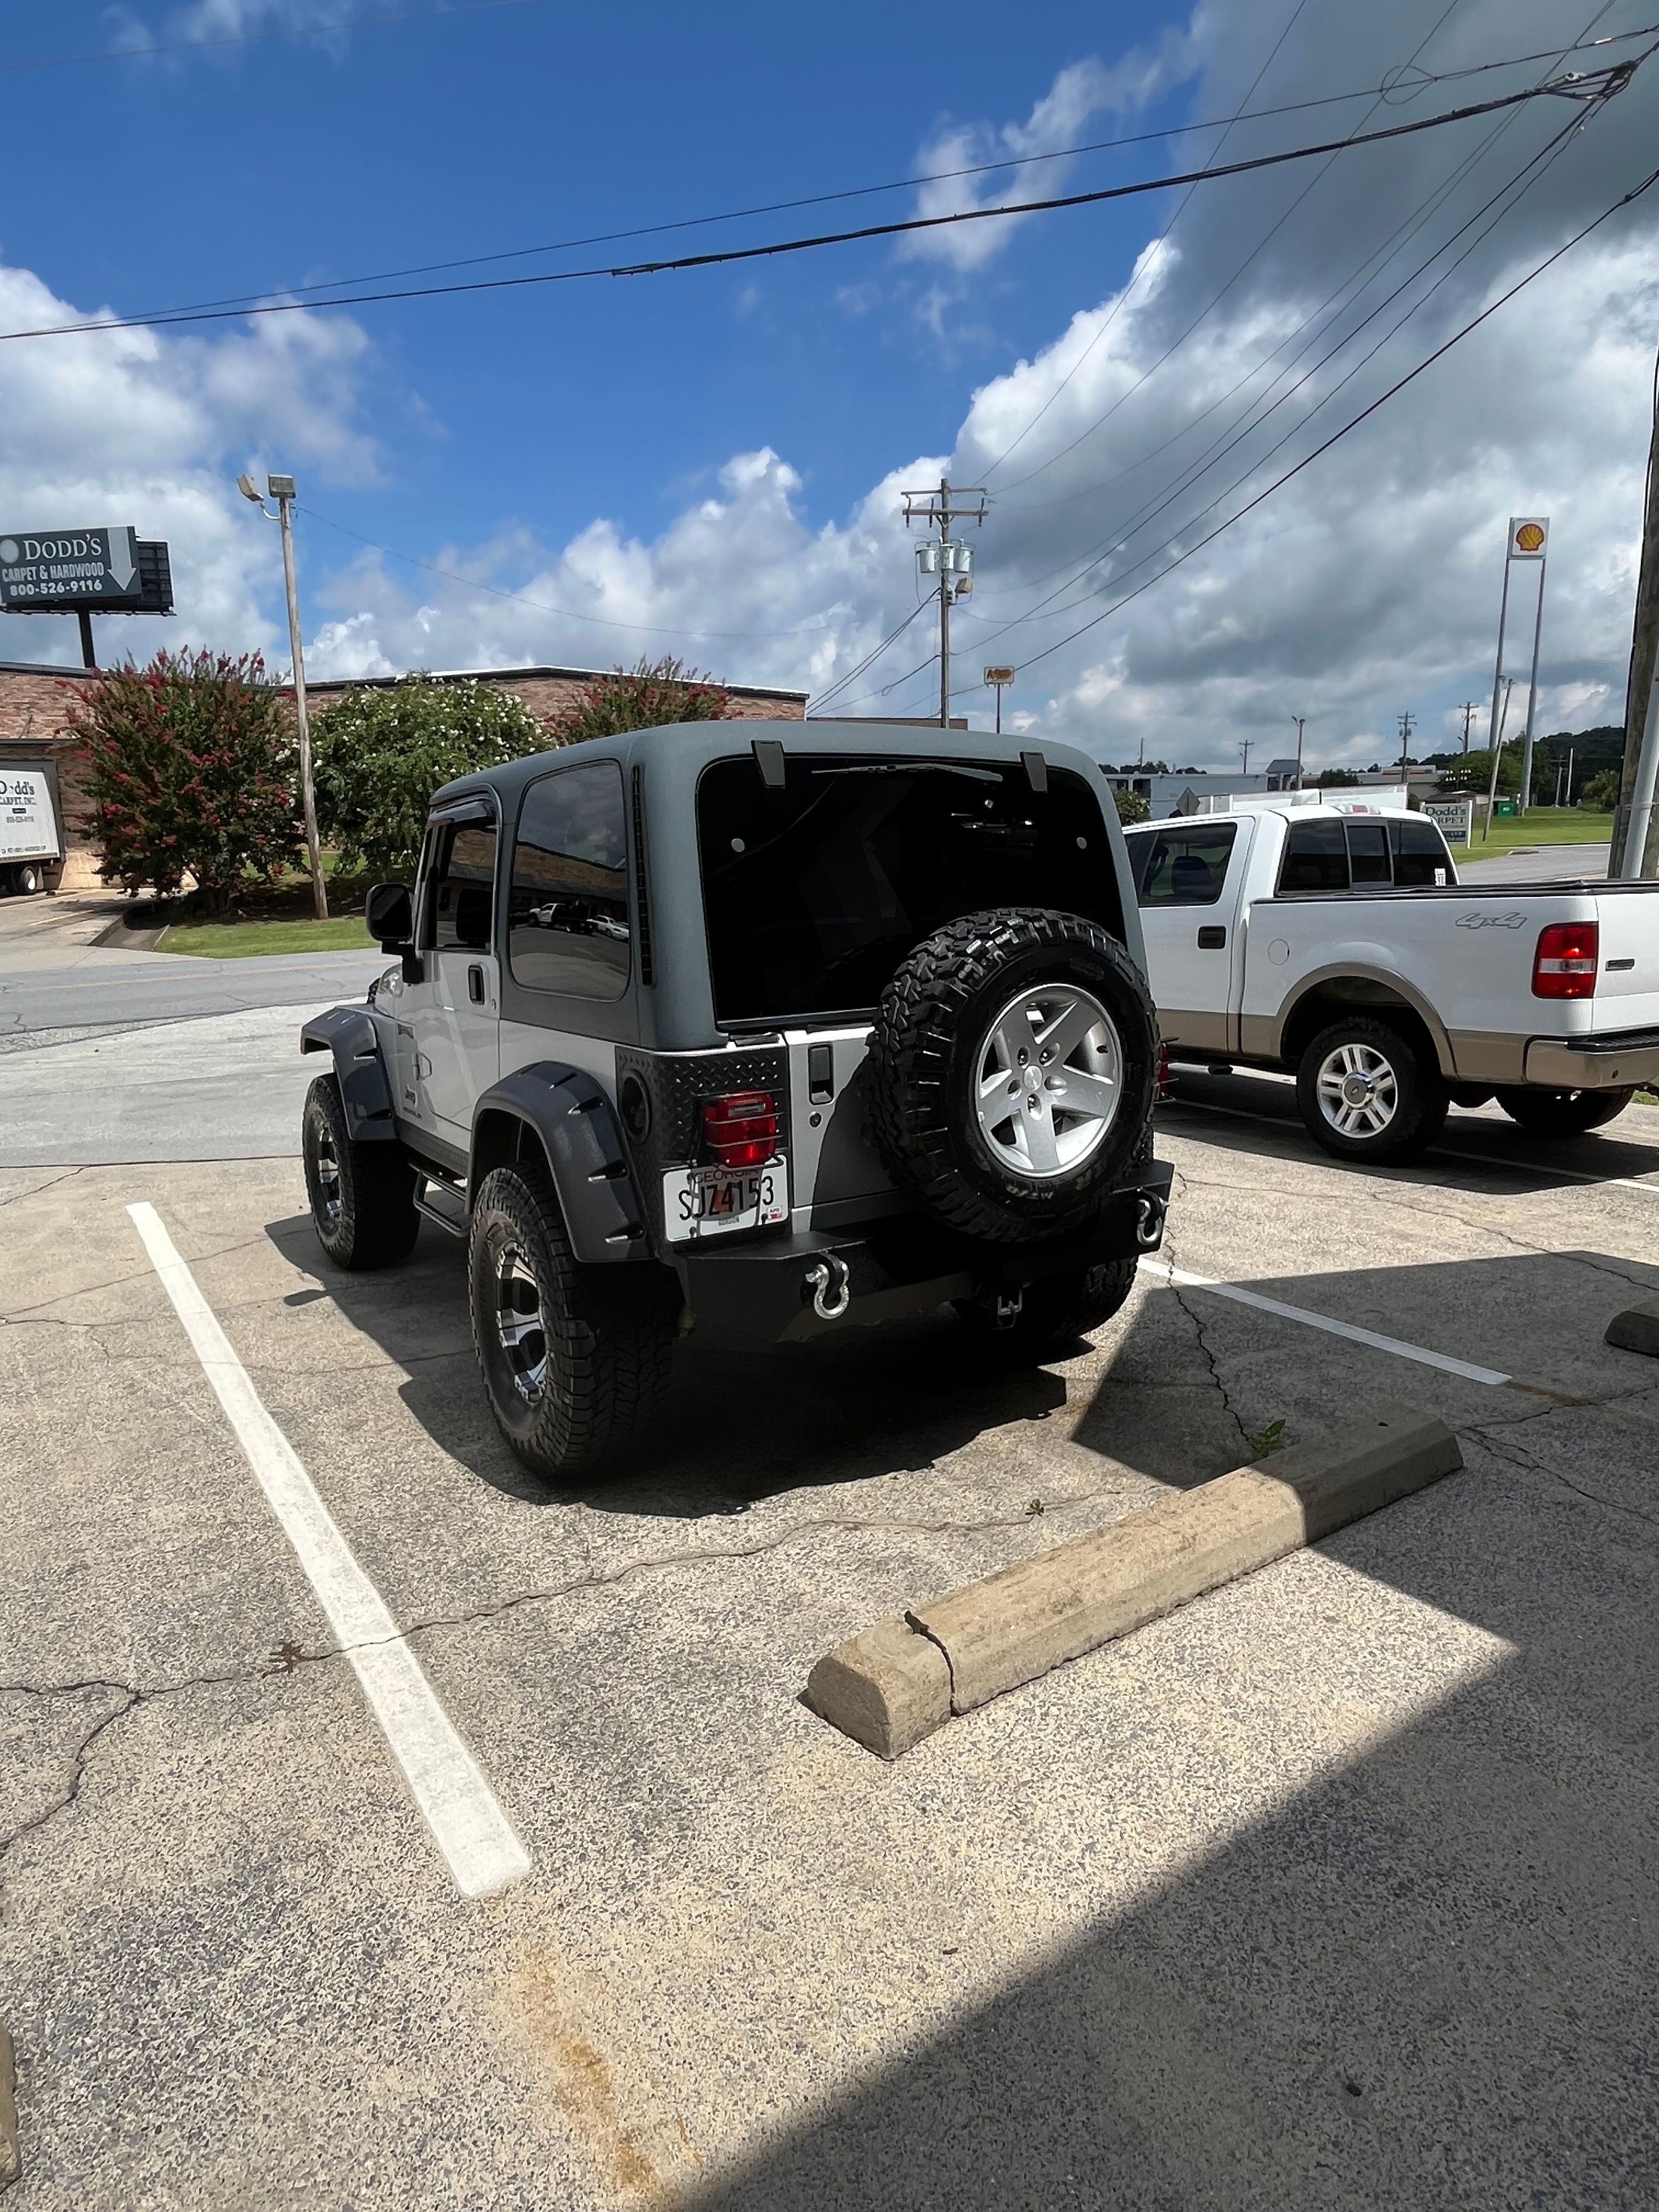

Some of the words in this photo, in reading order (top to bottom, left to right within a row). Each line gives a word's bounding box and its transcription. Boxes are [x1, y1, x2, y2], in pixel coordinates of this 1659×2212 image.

[23, 534, 103, 560] DODD'S
[2, 566, 37, 582] CARPET
[40, 565, 48, 580] &
[50, 562, 104, 579] HARDWOOD
[10, 579, 103, 596] 800-526-9116
[1426, 806, 1466, 816] Dodd's
[1455, 912, 1527, 929] 4x4
[679, 1175, 774, 1221] SJZ4153
